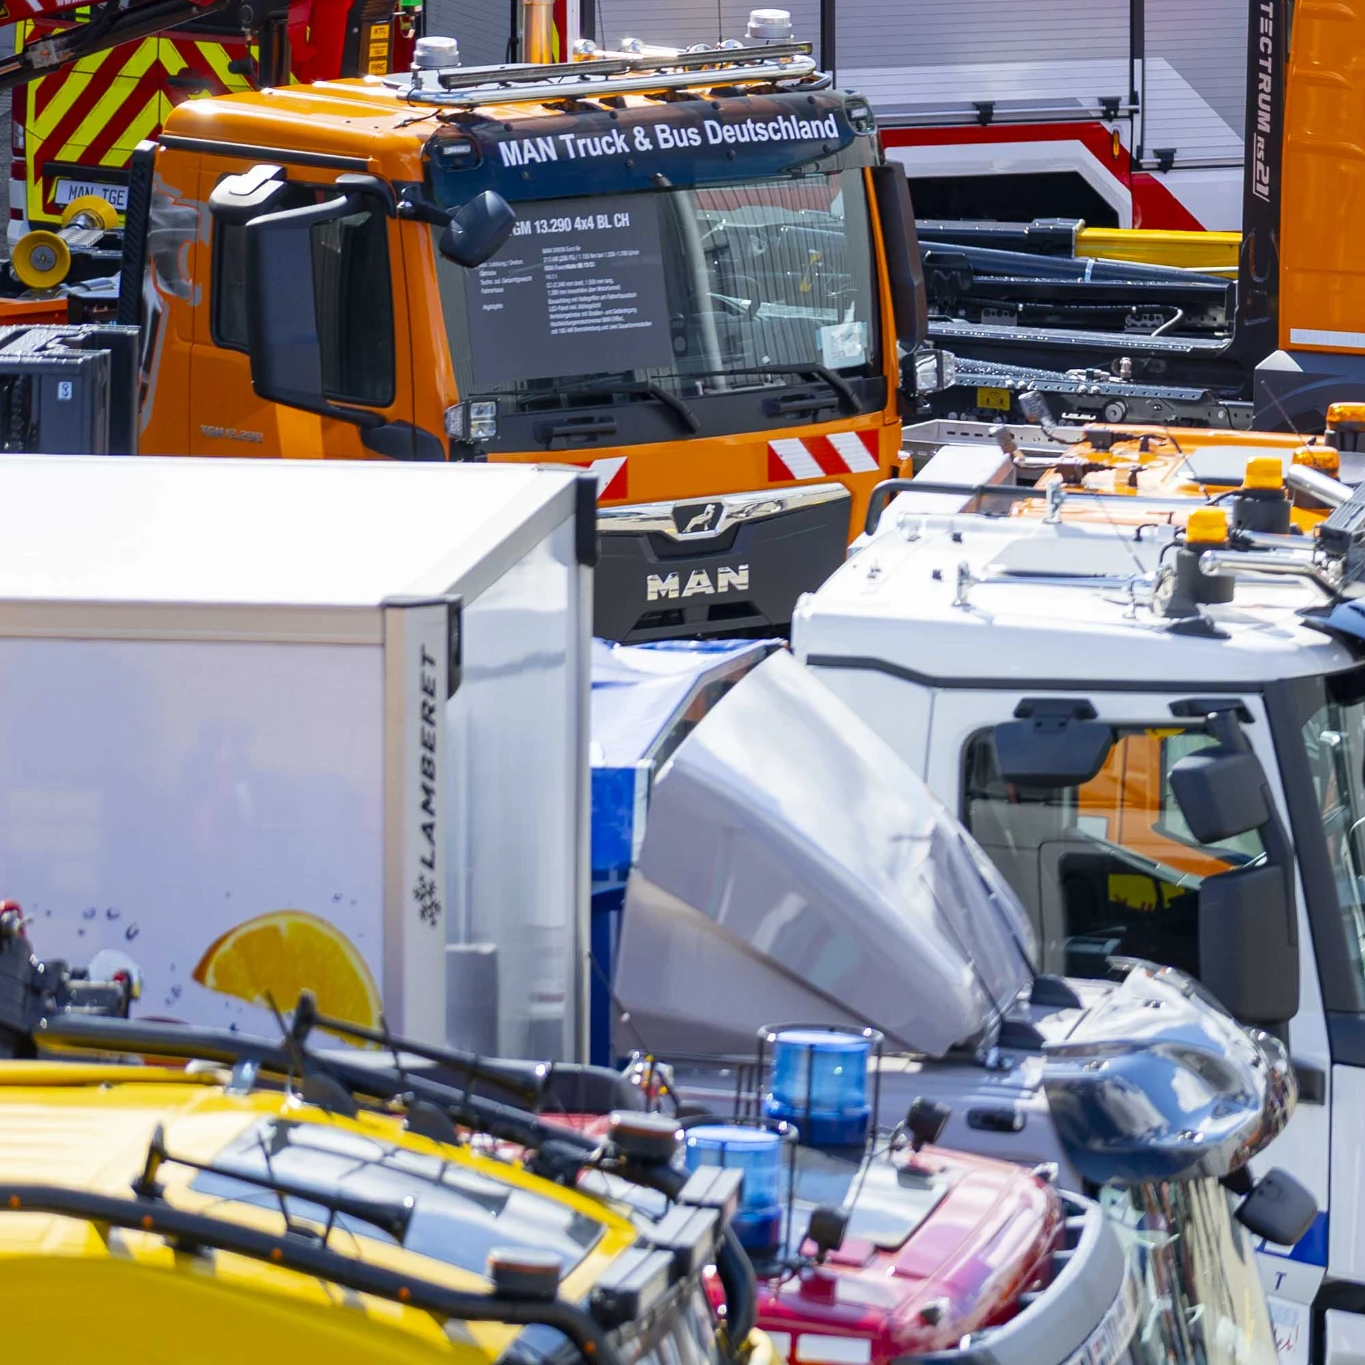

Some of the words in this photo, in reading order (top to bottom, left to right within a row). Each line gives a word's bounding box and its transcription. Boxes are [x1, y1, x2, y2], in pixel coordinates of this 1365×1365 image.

[1257, 2, 1274, 134] TECTRUM
[498, 136, 558, 167] MAN
[558, 128, 630, 160] Truck
[633, 125, 653, 152] &
[654, 123, 702, 150] Bus
[703, 113, 840, 145] Deutschland
[102, 187, 126, 206] TGE
[510, 221, 532, 236] GM
[534, 218, 572, 235] 13.290
[574, 216, 594, 231] 4x4
[597, 213, 612, 229] BL
[614, 212, 631, 228] CH
[647, 564, 750, 601] MAN
[419, 642, 437, 872] LAMBERET
